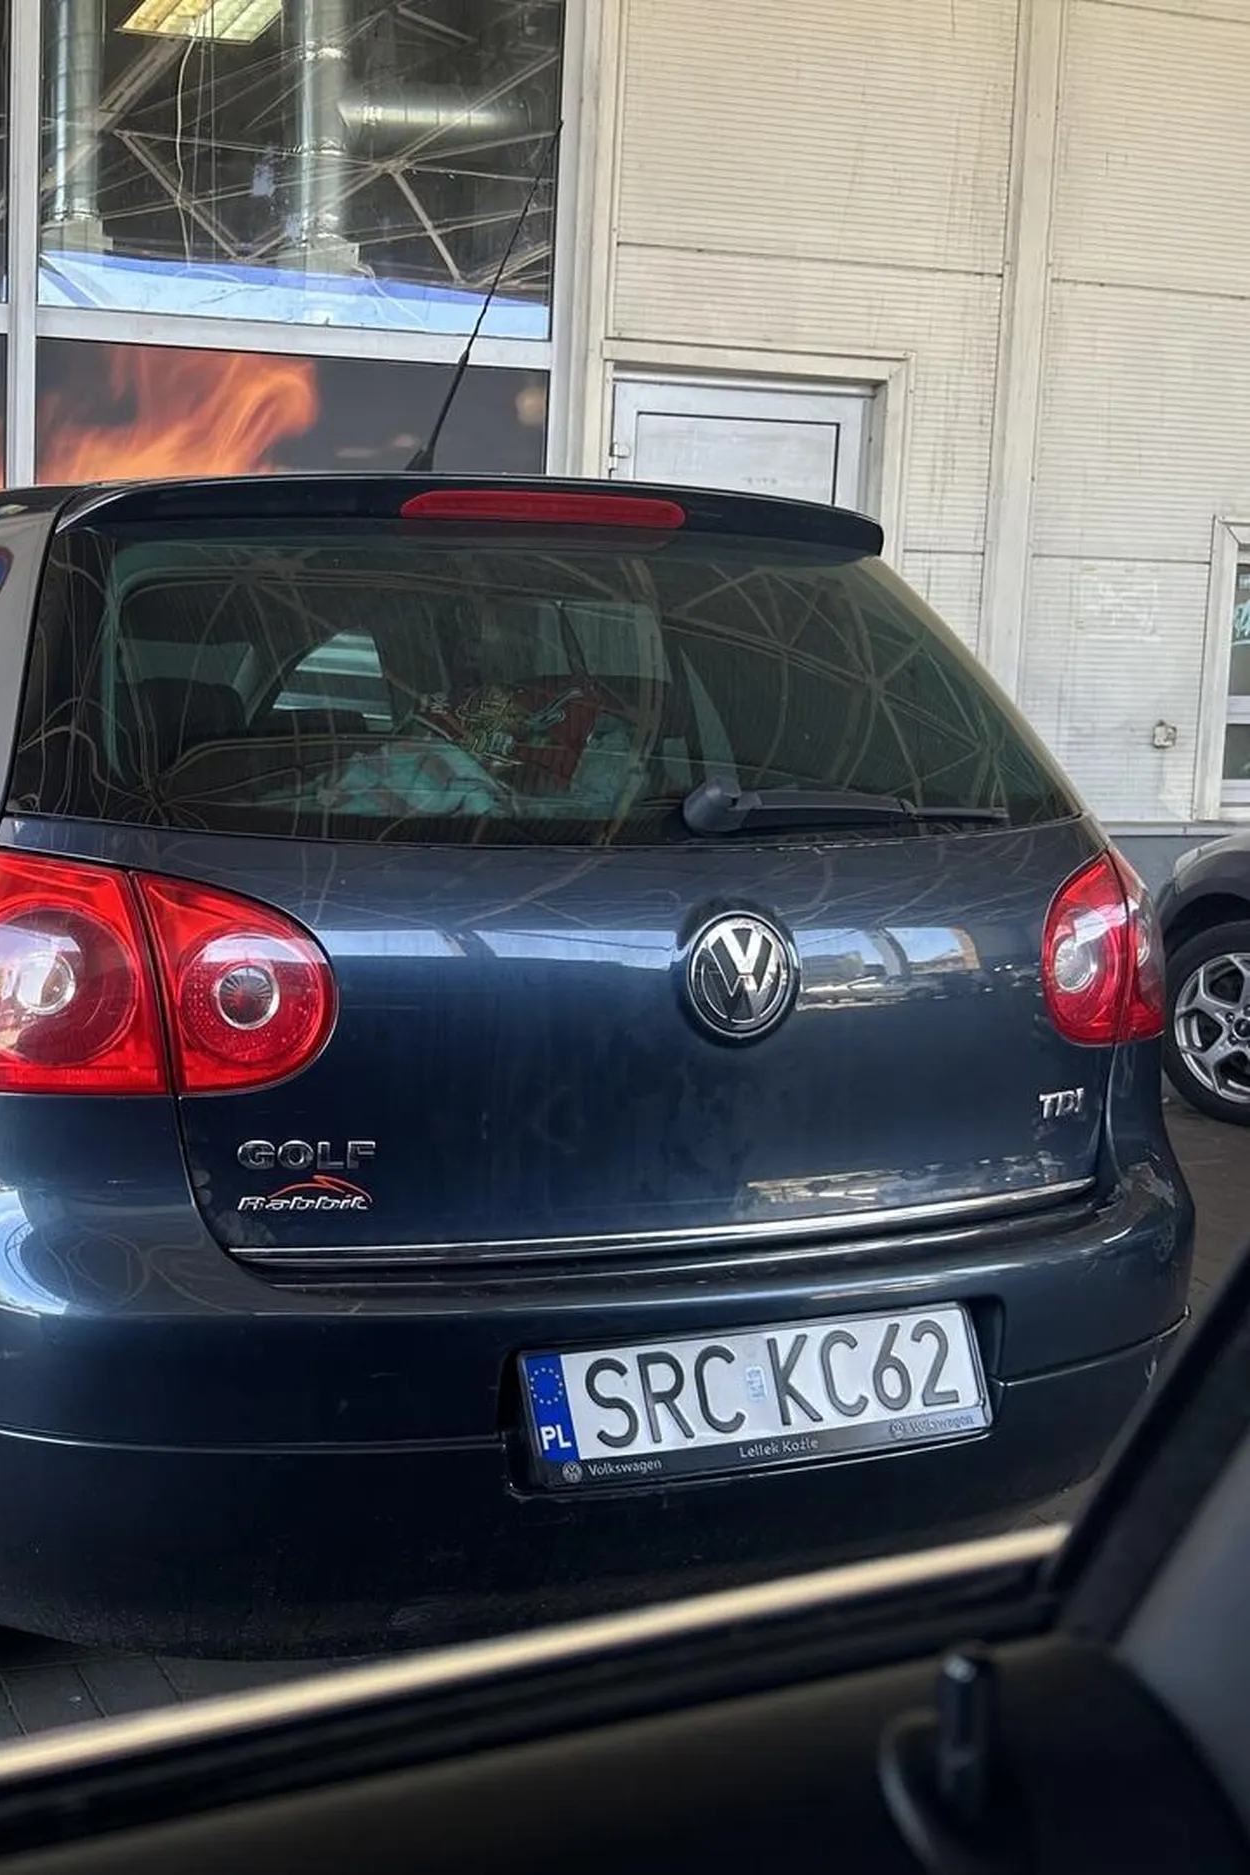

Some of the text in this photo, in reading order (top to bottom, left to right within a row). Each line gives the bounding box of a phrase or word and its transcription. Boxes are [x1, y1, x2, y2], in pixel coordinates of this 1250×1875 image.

[1039, 1088, 1084, 1119] TDI
[237, 1140, 376, 1170] GOLF
[237, 1194, 370, 1211] Rabbit
[584, 1319, 960, 1449] SRC KC62
[910, 1413, 976, 1434] Volkswagen
[540, 1425, 572, 1451] PL
[587, 1458, 663, 1477] Volkswagen
